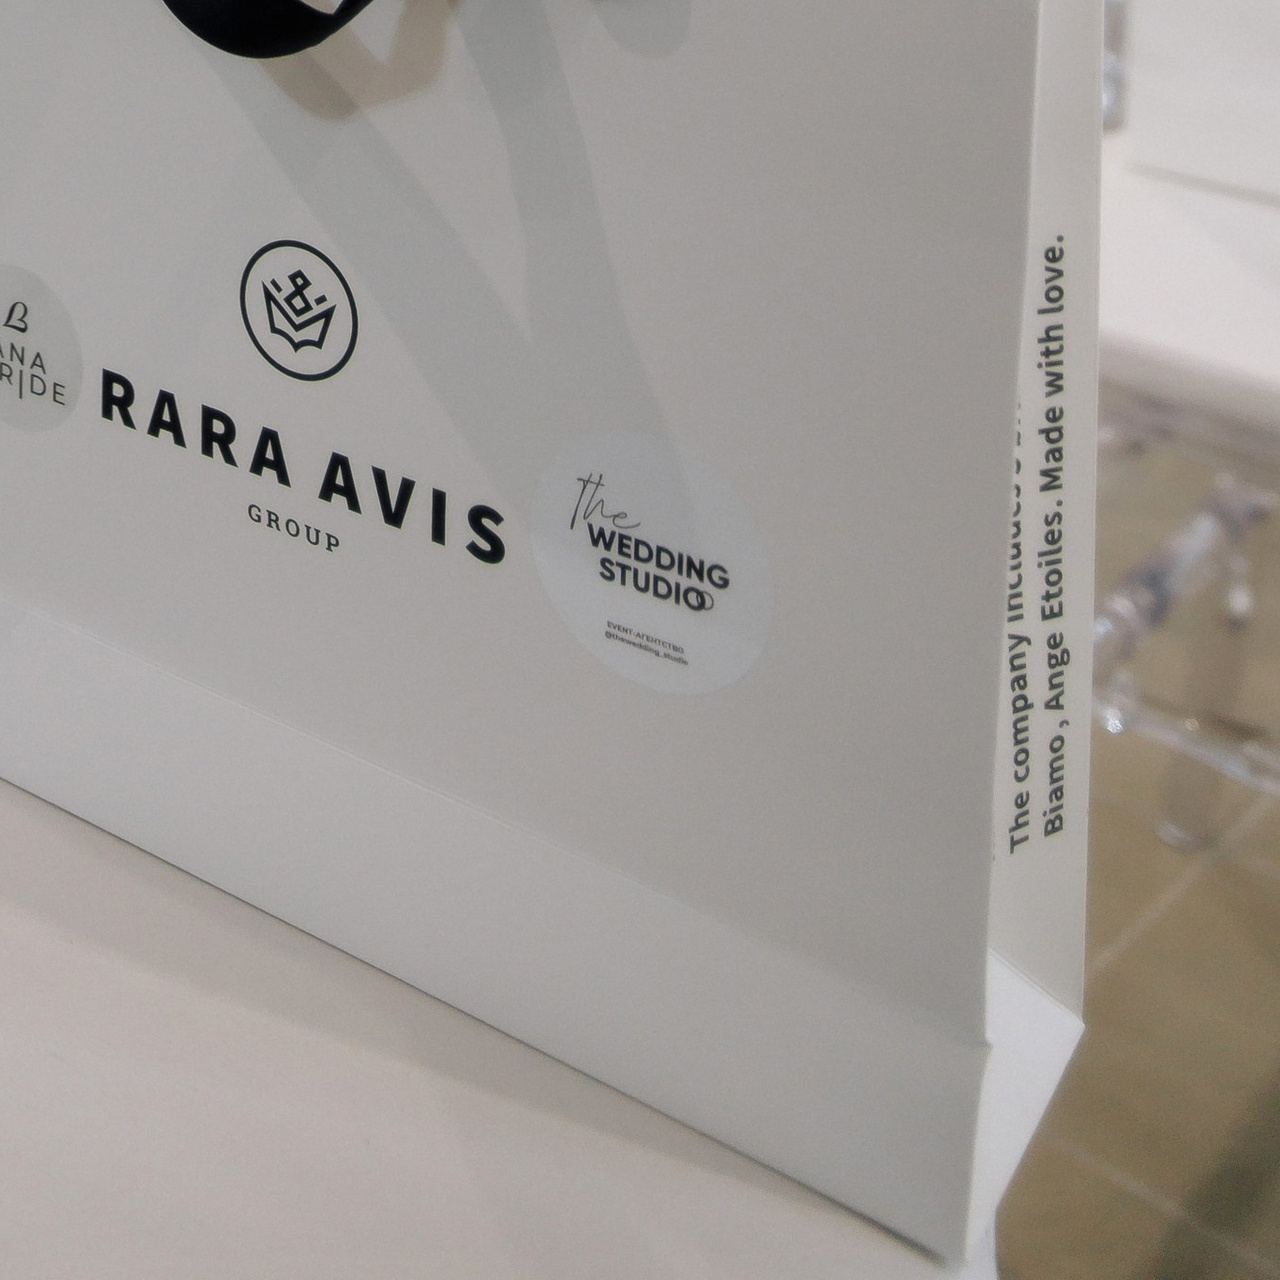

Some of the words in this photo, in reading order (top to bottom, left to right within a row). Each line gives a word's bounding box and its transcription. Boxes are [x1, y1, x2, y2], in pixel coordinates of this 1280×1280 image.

[1036, 234, 1065, 316] love.
[1036, 322, 1065, 398] with
[101, 368, 292, 488] RARA
[318, 451, 506, 565] AVIS
[1037, 406, 1065, 493] Made
[247, 503, 341, 553] GROUP
[587, 522, 730, 590] WEDDING
[1037, 500, 1064, 622] Etoiles.
[599, 557, 708, 612] STUDIO
[1008, 632, 1035, 783] company
[1044, 631, 1071, 711] Ange
[1009, 789, 1031, 855] The
